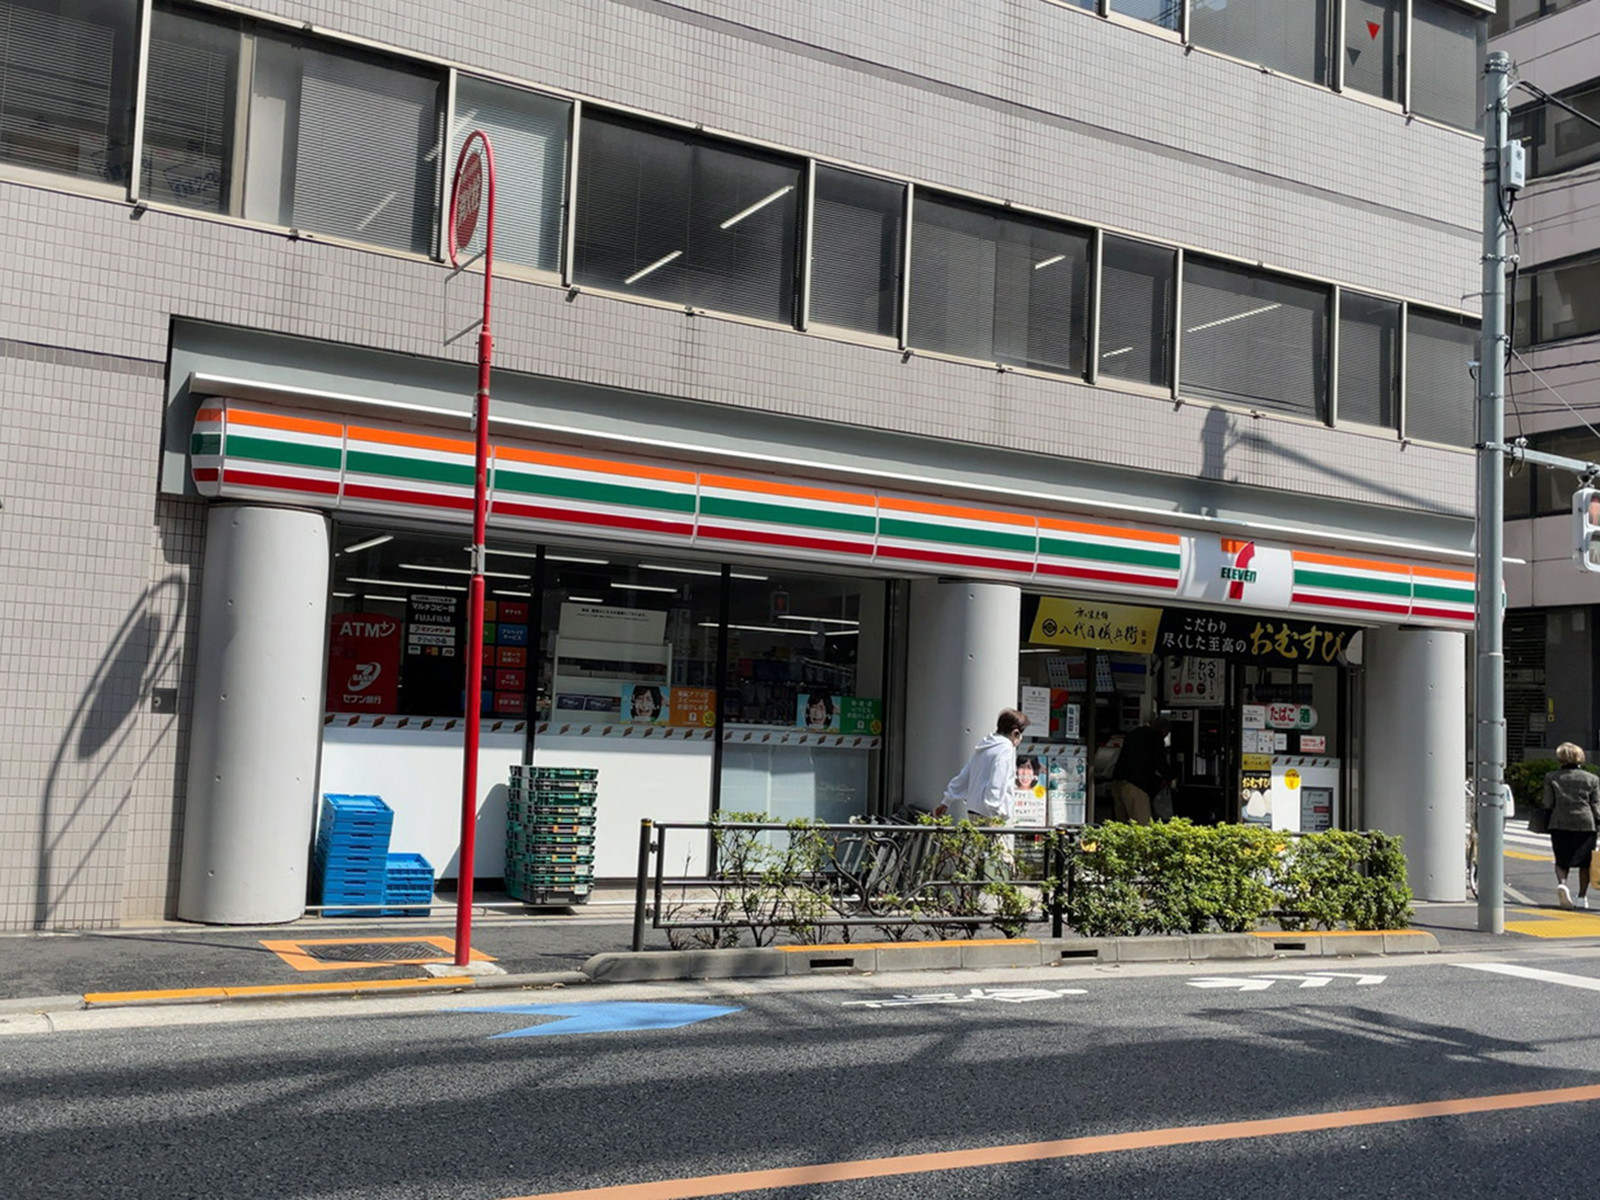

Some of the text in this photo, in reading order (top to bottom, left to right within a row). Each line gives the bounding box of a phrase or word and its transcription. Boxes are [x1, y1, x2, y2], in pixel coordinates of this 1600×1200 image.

[1059, 621, 1139, 646] 八代目儀兵衛
[1184, 617, 1227, 634] こだわり
[1162, 631, 1247, 654] 尽くした至高の
[1250, 620, 1346, 663] おむすび
[1269, 706, 1296, 722] たばこ
[1299, 708, 1310, 723] 酒
